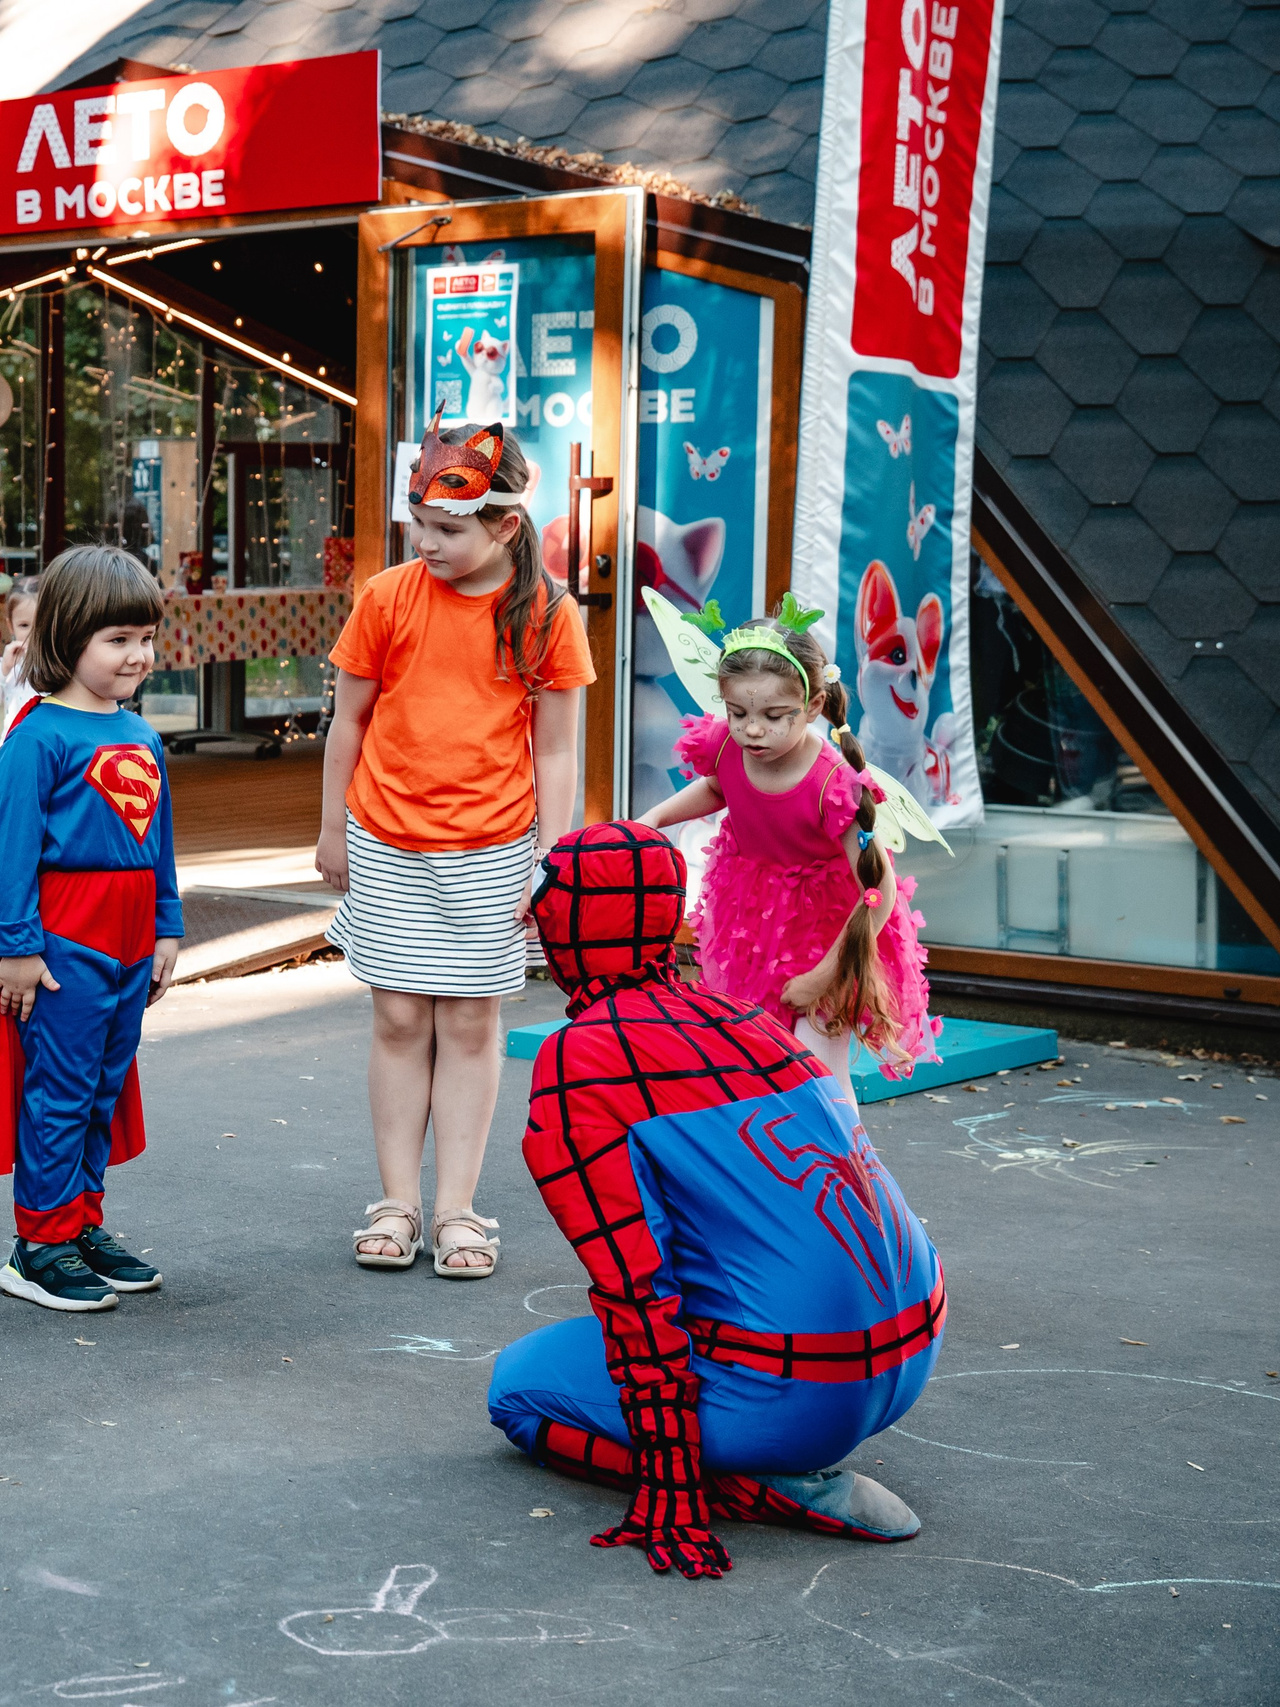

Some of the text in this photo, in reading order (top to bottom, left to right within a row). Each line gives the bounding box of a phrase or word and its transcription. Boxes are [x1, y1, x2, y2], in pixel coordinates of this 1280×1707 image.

[16, 82, 225, 173] ЛЕТО
[16, 168, 226, 225] В МОСКВЕ
[891, 0, 927, 303] ЛЕТО
[918, 1, 959, 316] В МОСКВЕ
